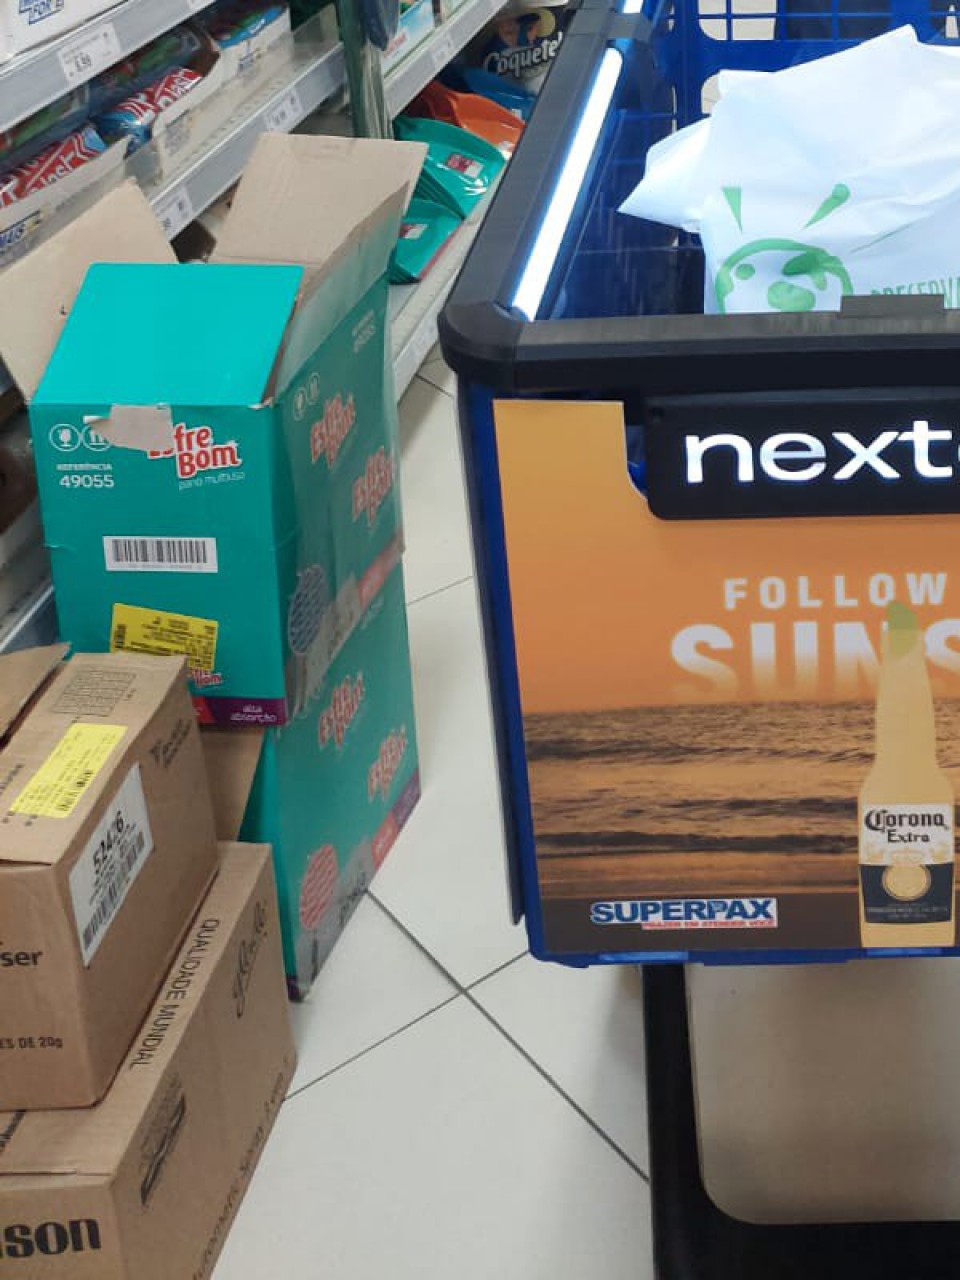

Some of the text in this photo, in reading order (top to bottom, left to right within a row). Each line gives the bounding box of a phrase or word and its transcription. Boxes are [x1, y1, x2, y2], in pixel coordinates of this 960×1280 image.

[178, 442, 243, 478] Bom
[59, 474, 115, 489] 49055
[724, 572, 948, 610] FOLLOW
[865, 809, 949, 833] Corona
[887, 829, 931, 844] Extra
[591, 898, 775, 923] SUPERPAX
[129, 917, 220, 1070] QUALIDADE MUNDIAL
[38, 1035, 63, 1049] 20g
[0, 1218, 102, 1259] son
